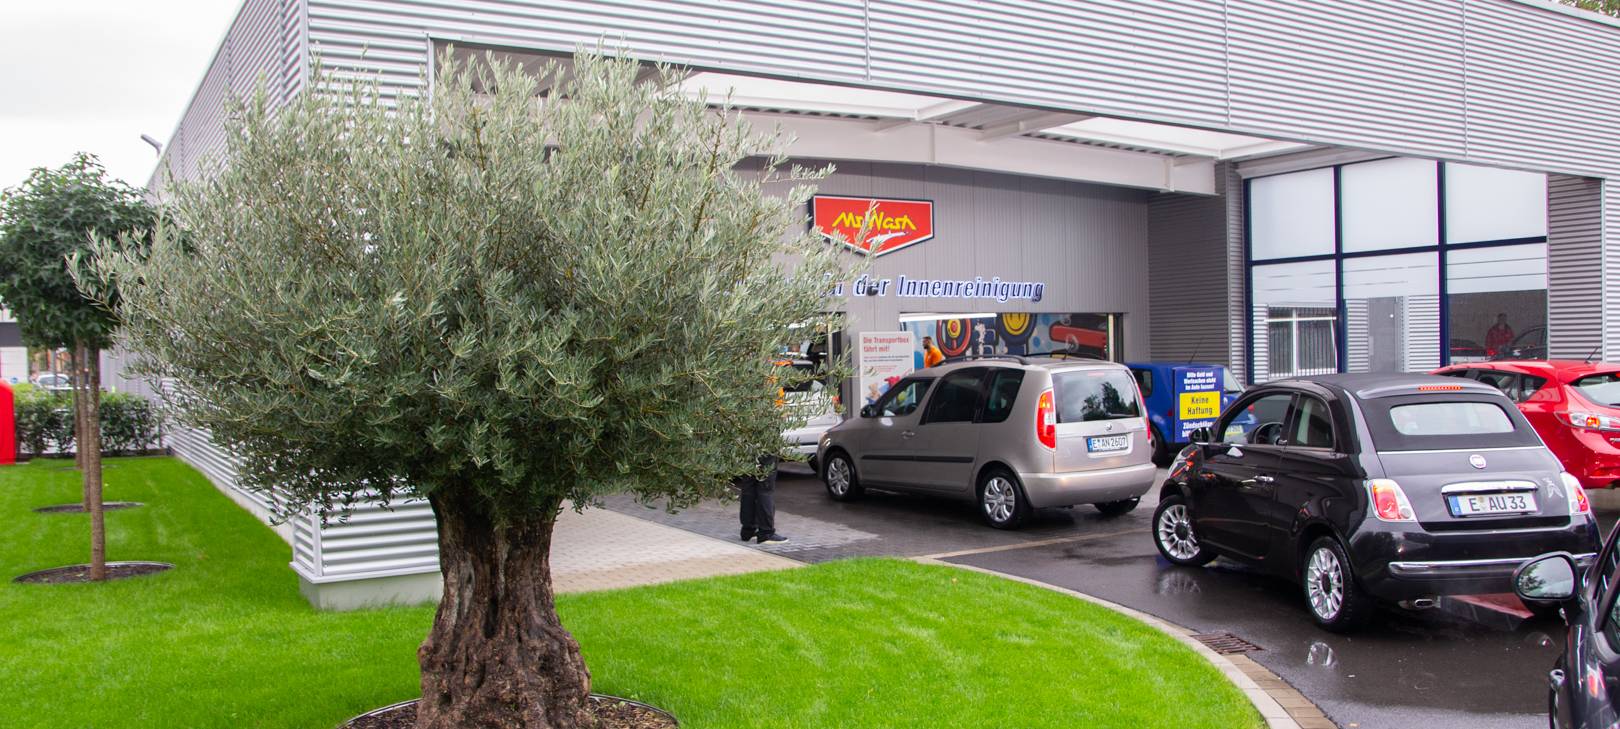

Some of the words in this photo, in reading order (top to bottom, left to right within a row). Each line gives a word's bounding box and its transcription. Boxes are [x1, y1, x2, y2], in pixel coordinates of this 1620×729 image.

[854, 273, 890, 296] der
[896, 274, 1045, 303] Innenreinigung
[1187, 407, 1213, 416] Haftung
[1469, 497, 1480, 512] E
[1488, 496, 1508, 511] AU
[1507, 495, 1527, 510] 33
